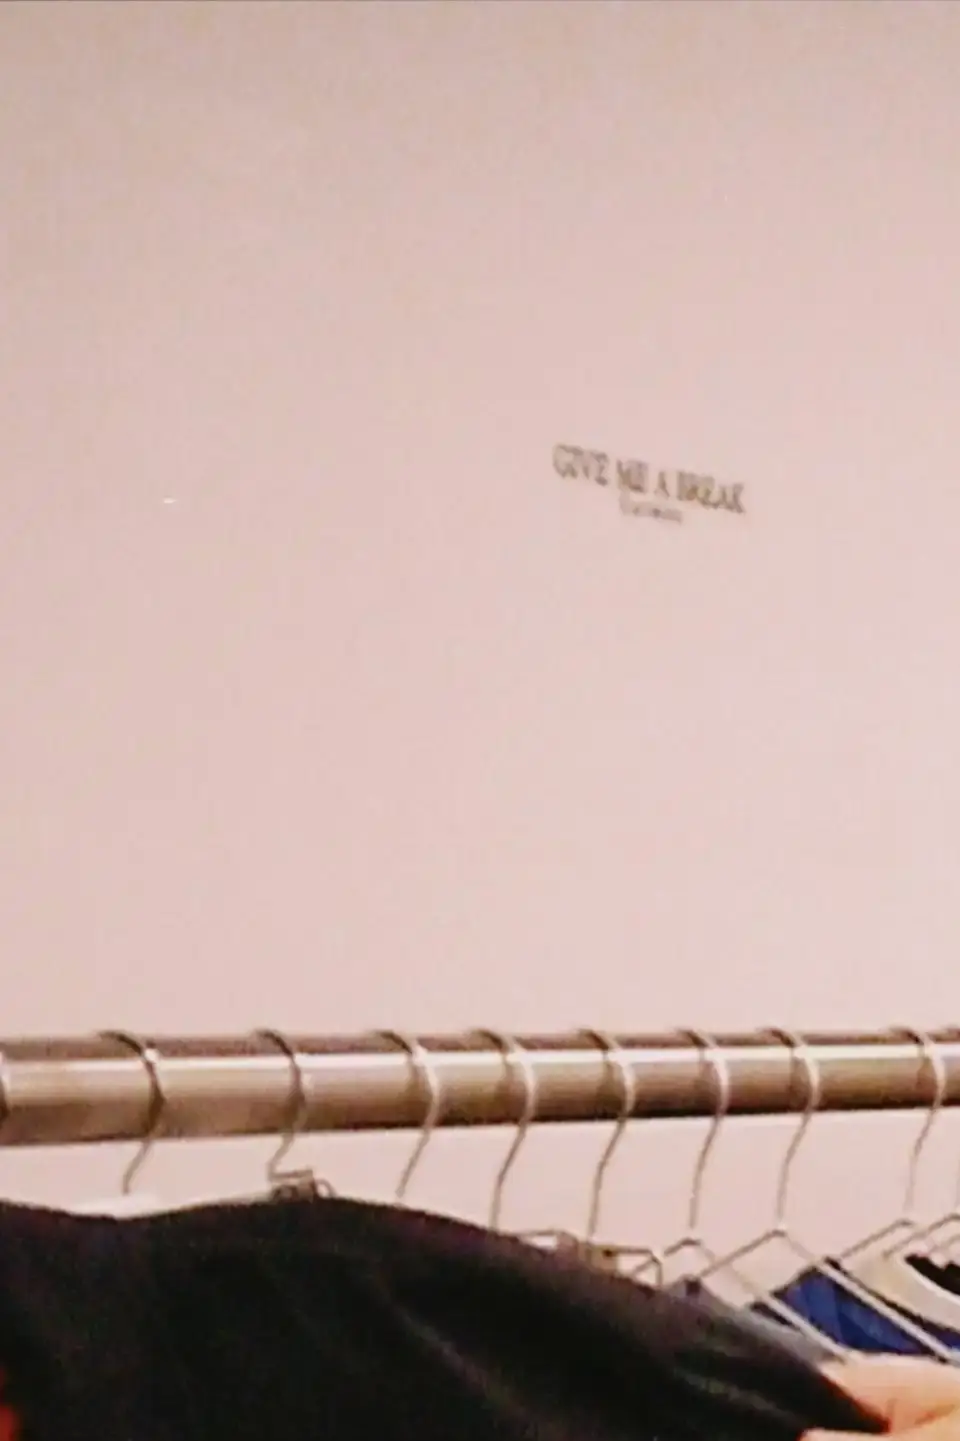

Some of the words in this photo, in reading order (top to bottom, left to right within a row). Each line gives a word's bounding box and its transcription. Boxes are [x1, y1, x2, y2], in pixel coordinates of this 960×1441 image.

[552, 443, 609, 488] GIVE
[615, 458, 650, 494] ME
[653, 470, 671, 499] A
[676, 469, 747, 515] BREAK
